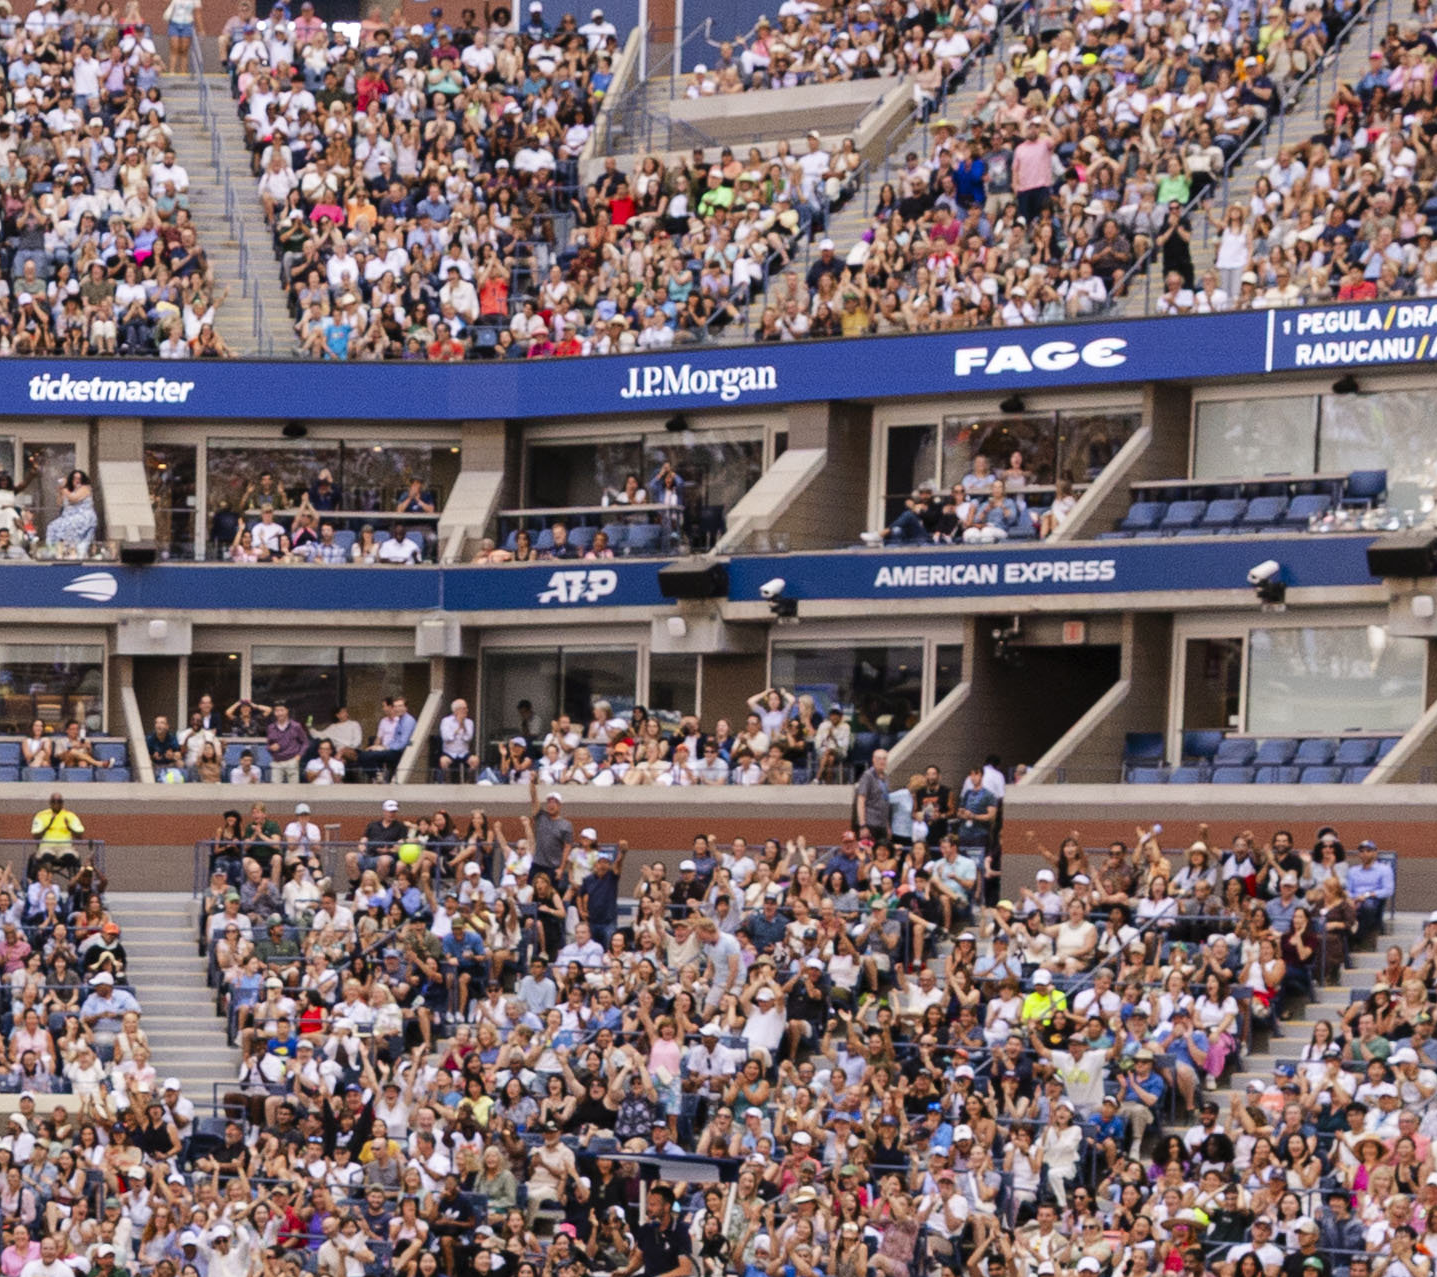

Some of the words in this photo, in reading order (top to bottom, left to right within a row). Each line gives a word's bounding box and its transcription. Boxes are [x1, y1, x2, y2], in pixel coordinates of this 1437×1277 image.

[1282, 319, 1291, 335] 1
[28, 372, 195, 403] ticketmaster
[620, 364, 778, 401] J.P.Morgan
[537, 568, 618, 604] ATP
[874, 563, 999, 587] AMERICAN
[1004, 559, 1116, 584] EXPRESS
